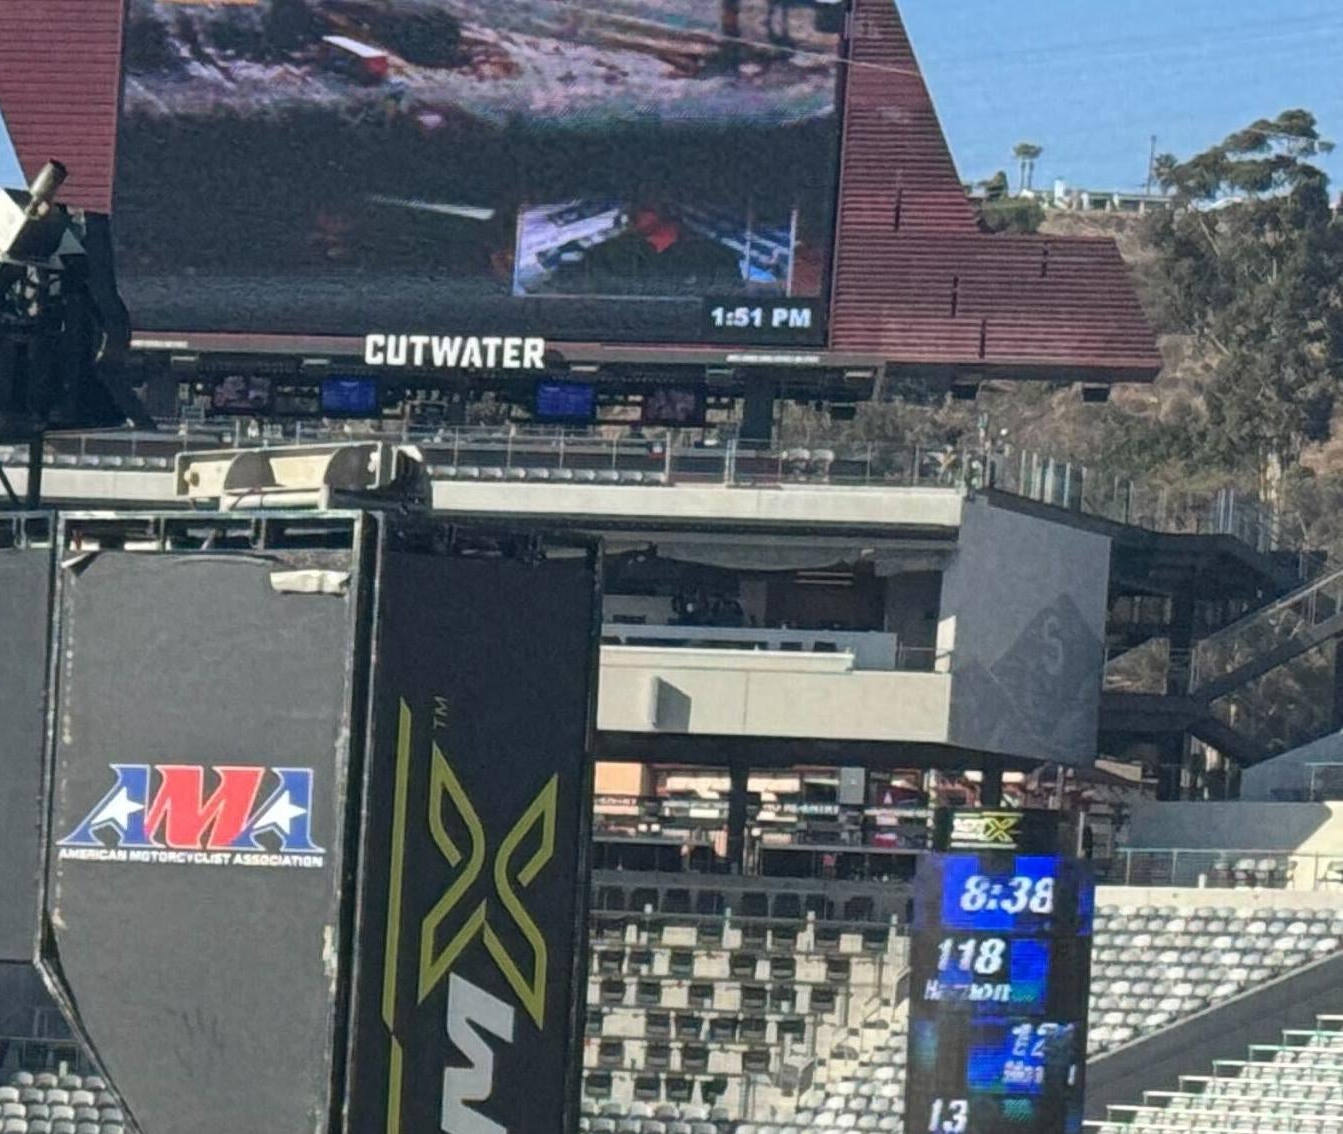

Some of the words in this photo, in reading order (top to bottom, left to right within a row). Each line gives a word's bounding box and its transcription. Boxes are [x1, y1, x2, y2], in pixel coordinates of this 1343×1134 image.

[712, 307, 764, 327] 1:51
[772, 308, 811, 328] PM
[365, 334, 544, 369] CUTWATER
[55, 764, 326, 853] AMA
[58, 849, 127, 862] AMERICAN
[129, 850, 230, 865] MOTORCYCLIST
[232, 854, 324, 868] ASSOCIATION
[960, 875, 1054, 914] 8:38
[937, 938, 1006, 975] 118
[928, 1098, 968, 1133] 13
